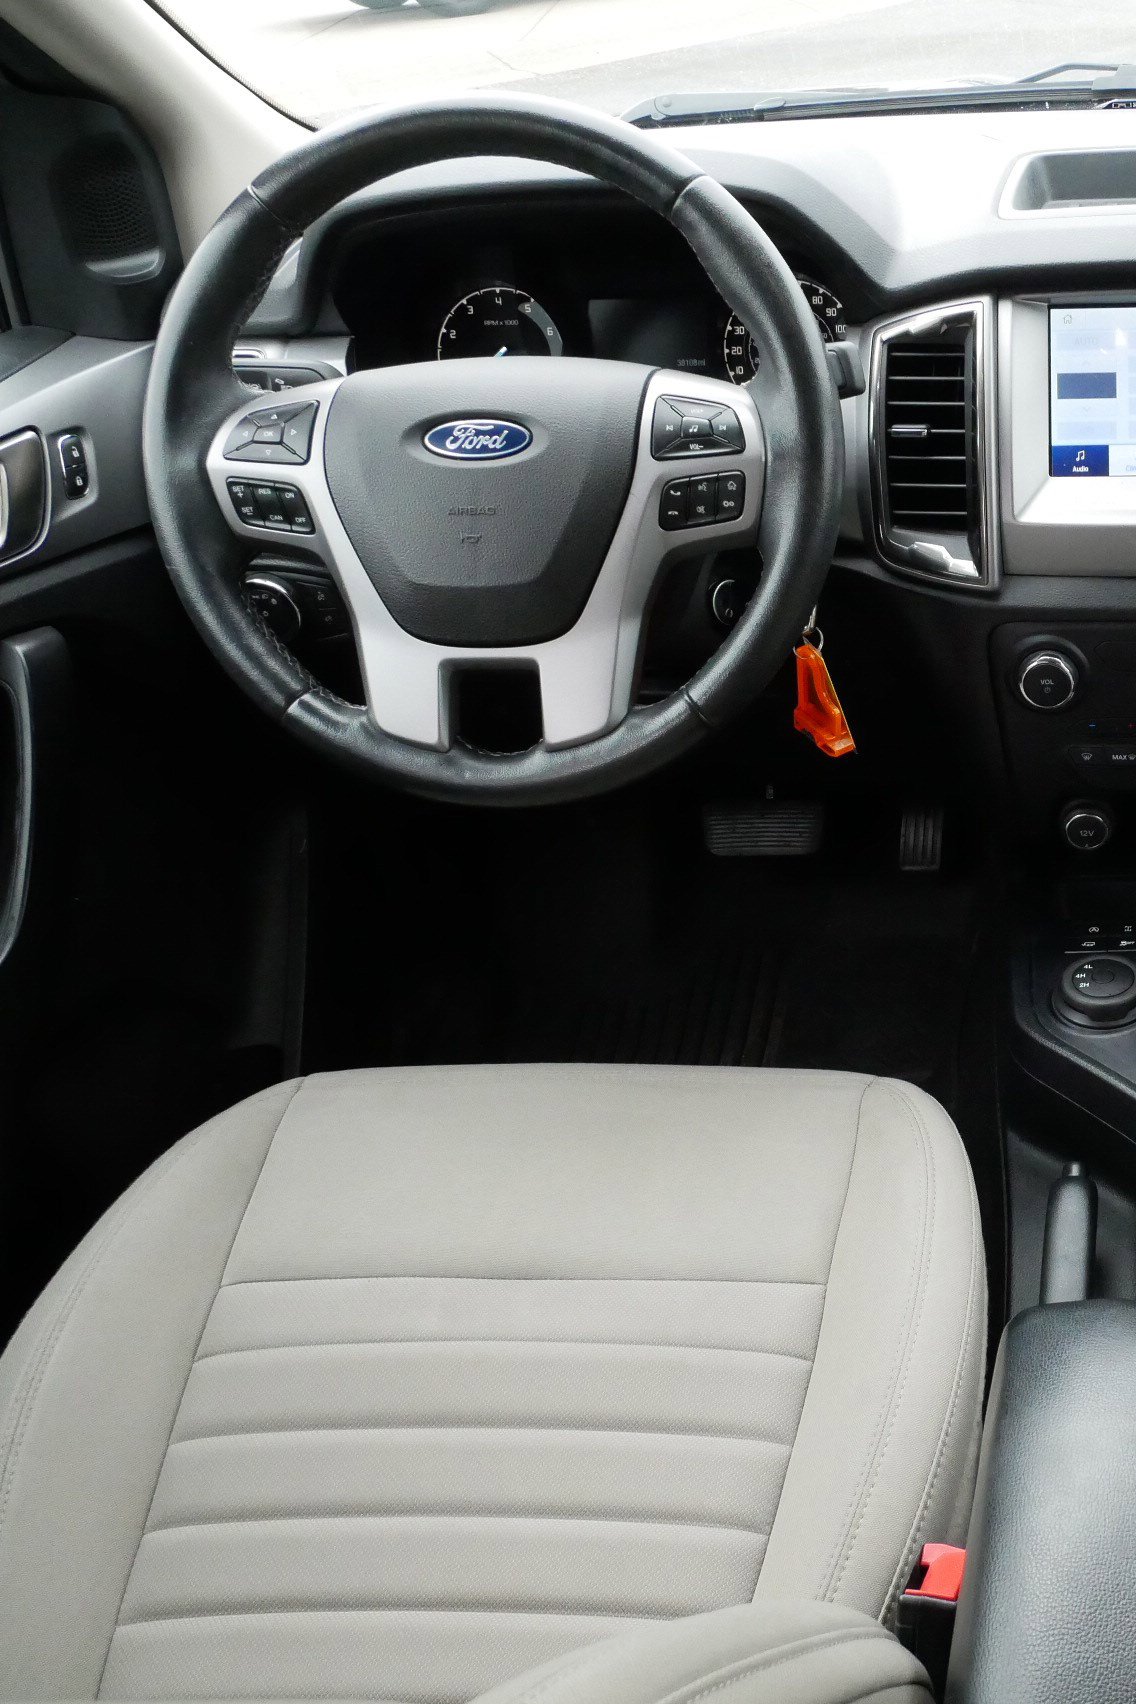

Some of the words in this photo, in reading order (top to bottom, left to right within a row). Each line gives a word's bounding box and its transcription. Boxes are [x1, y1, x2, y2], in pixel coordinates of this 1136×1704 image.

[495, 296, 502, 306] 4
[812, 296, 823, 304] 80
[466, 306, 474, 314] 3
[524, 304, 532, 313] 5
[826, 308, 837, 316] 90
[450, 330, 456, 339] 2
[546, 327, 554, 336] 6
[734, 326, 745, 335] 30
[731, 346, 743, 355] 20
[736, 366, 744, 375] 10
[445, 424, 508, 450] Ford
